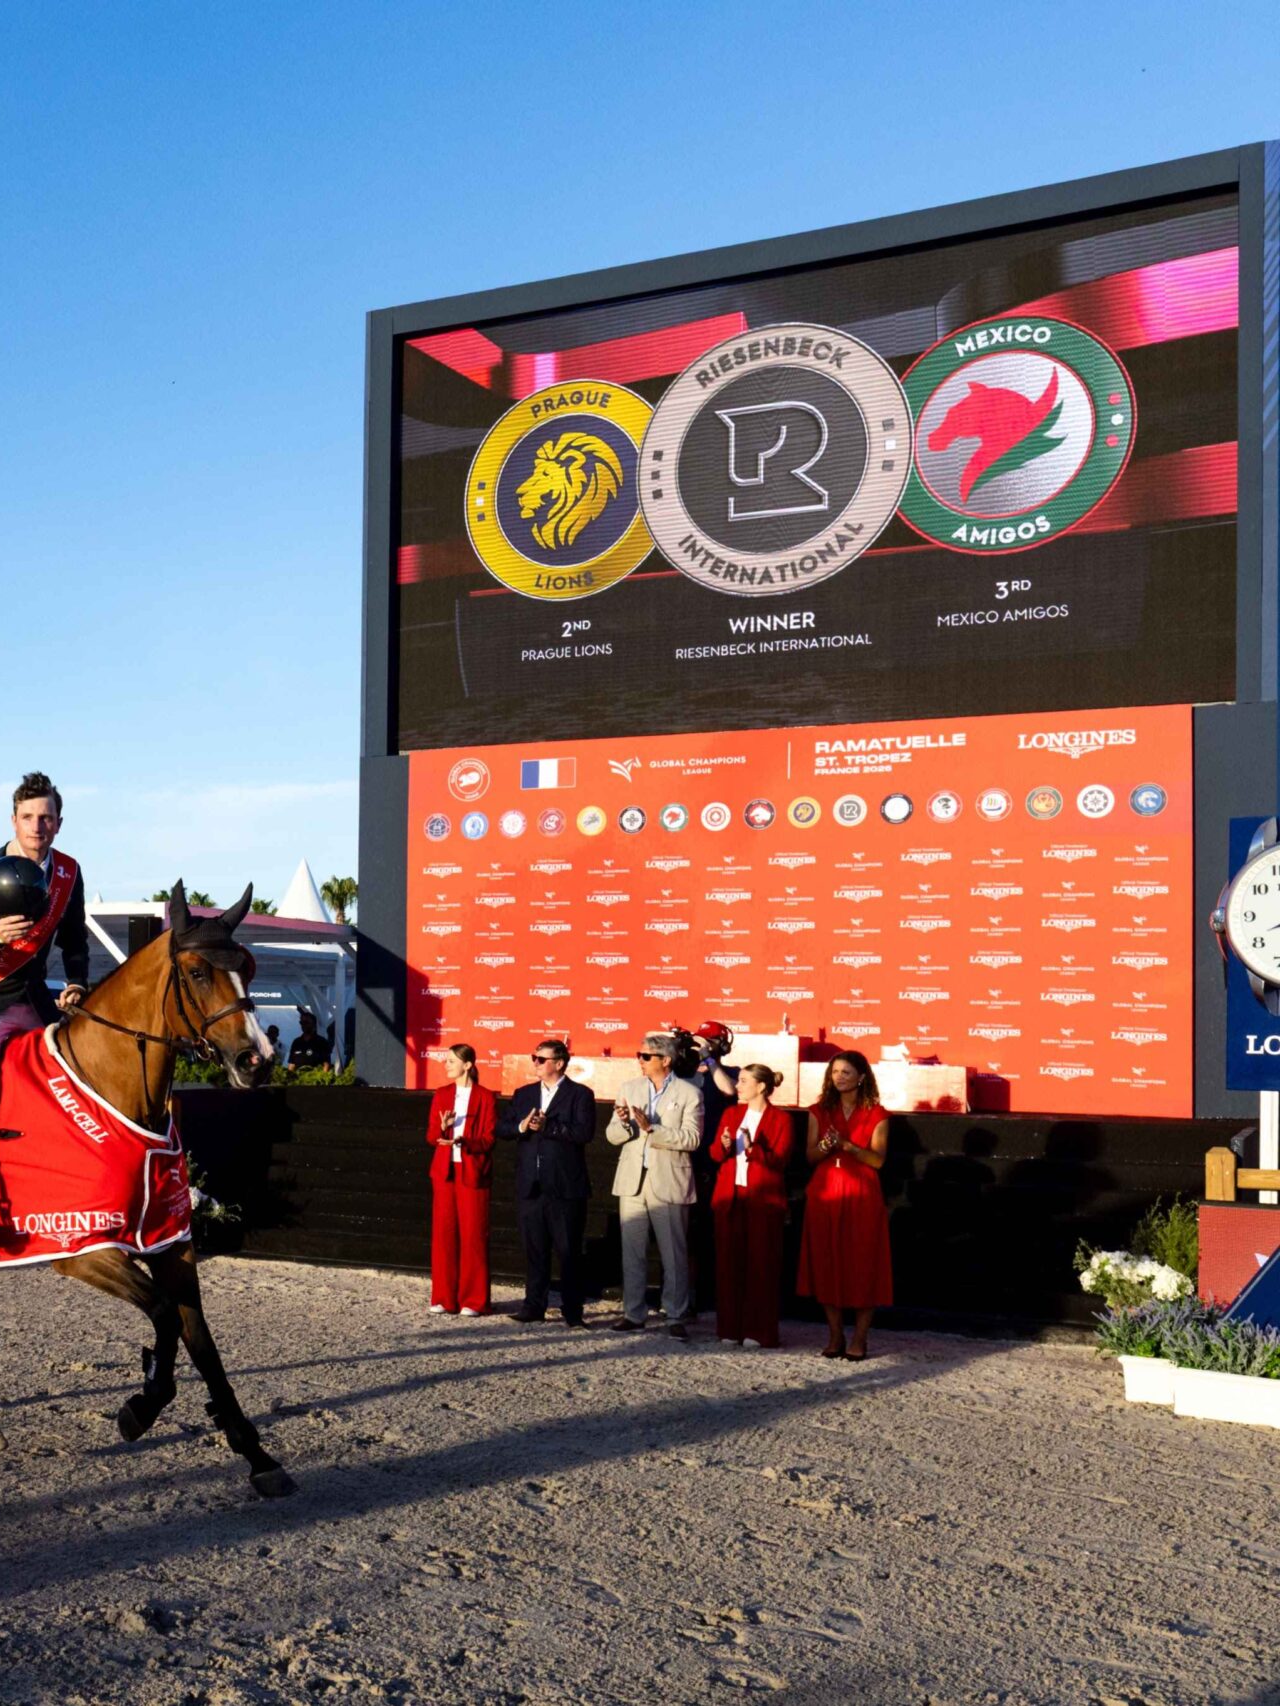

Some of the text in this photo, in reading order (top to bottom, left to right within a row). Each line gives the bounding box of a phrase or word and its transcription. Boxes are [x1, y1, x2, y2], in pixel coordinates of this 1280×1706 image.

[955, 325, 1051, 357] MEXICO
[695, 336, 851, 389] RIESENBECK
[531, 391, 611, 418] PRAGUE
[951, 516, 1051, 545] AMIGOS
[678, 519, 864, 585] INTERNATIONAL
[534, 570, 594, 591] LIONS
[995, 579, 1031, 600] 3RD
[728, 611, 815, 634] WINNER
[937, 604, 1069, 627] MEXICO AMIGOS
[561, 620, 591, 638] 2ND
[521, 643, 613, 661] PRAGUE LIONS
[675, 634, 872, 659] RIESENBECK INTERNATIONAL
[815, 733, 966, 753] RAMATUELLE
[1018, 729, 1136, 749] LONGINES
[650, 756, 746, 768] GLOBAL CHAMPIONS
[815, 753, 912, 767] ST. TROPEZ
[814, 767, 860, 775] FRANCE
[1252, 883, 1269, 896] 10
[1243, 910, 1256, 922] 9
[1252, 937, 1265, 949] 8
[48, 1075, 110, 1144] LAMI-CELL
[12, 1211, 125, 1235] LONGINES
